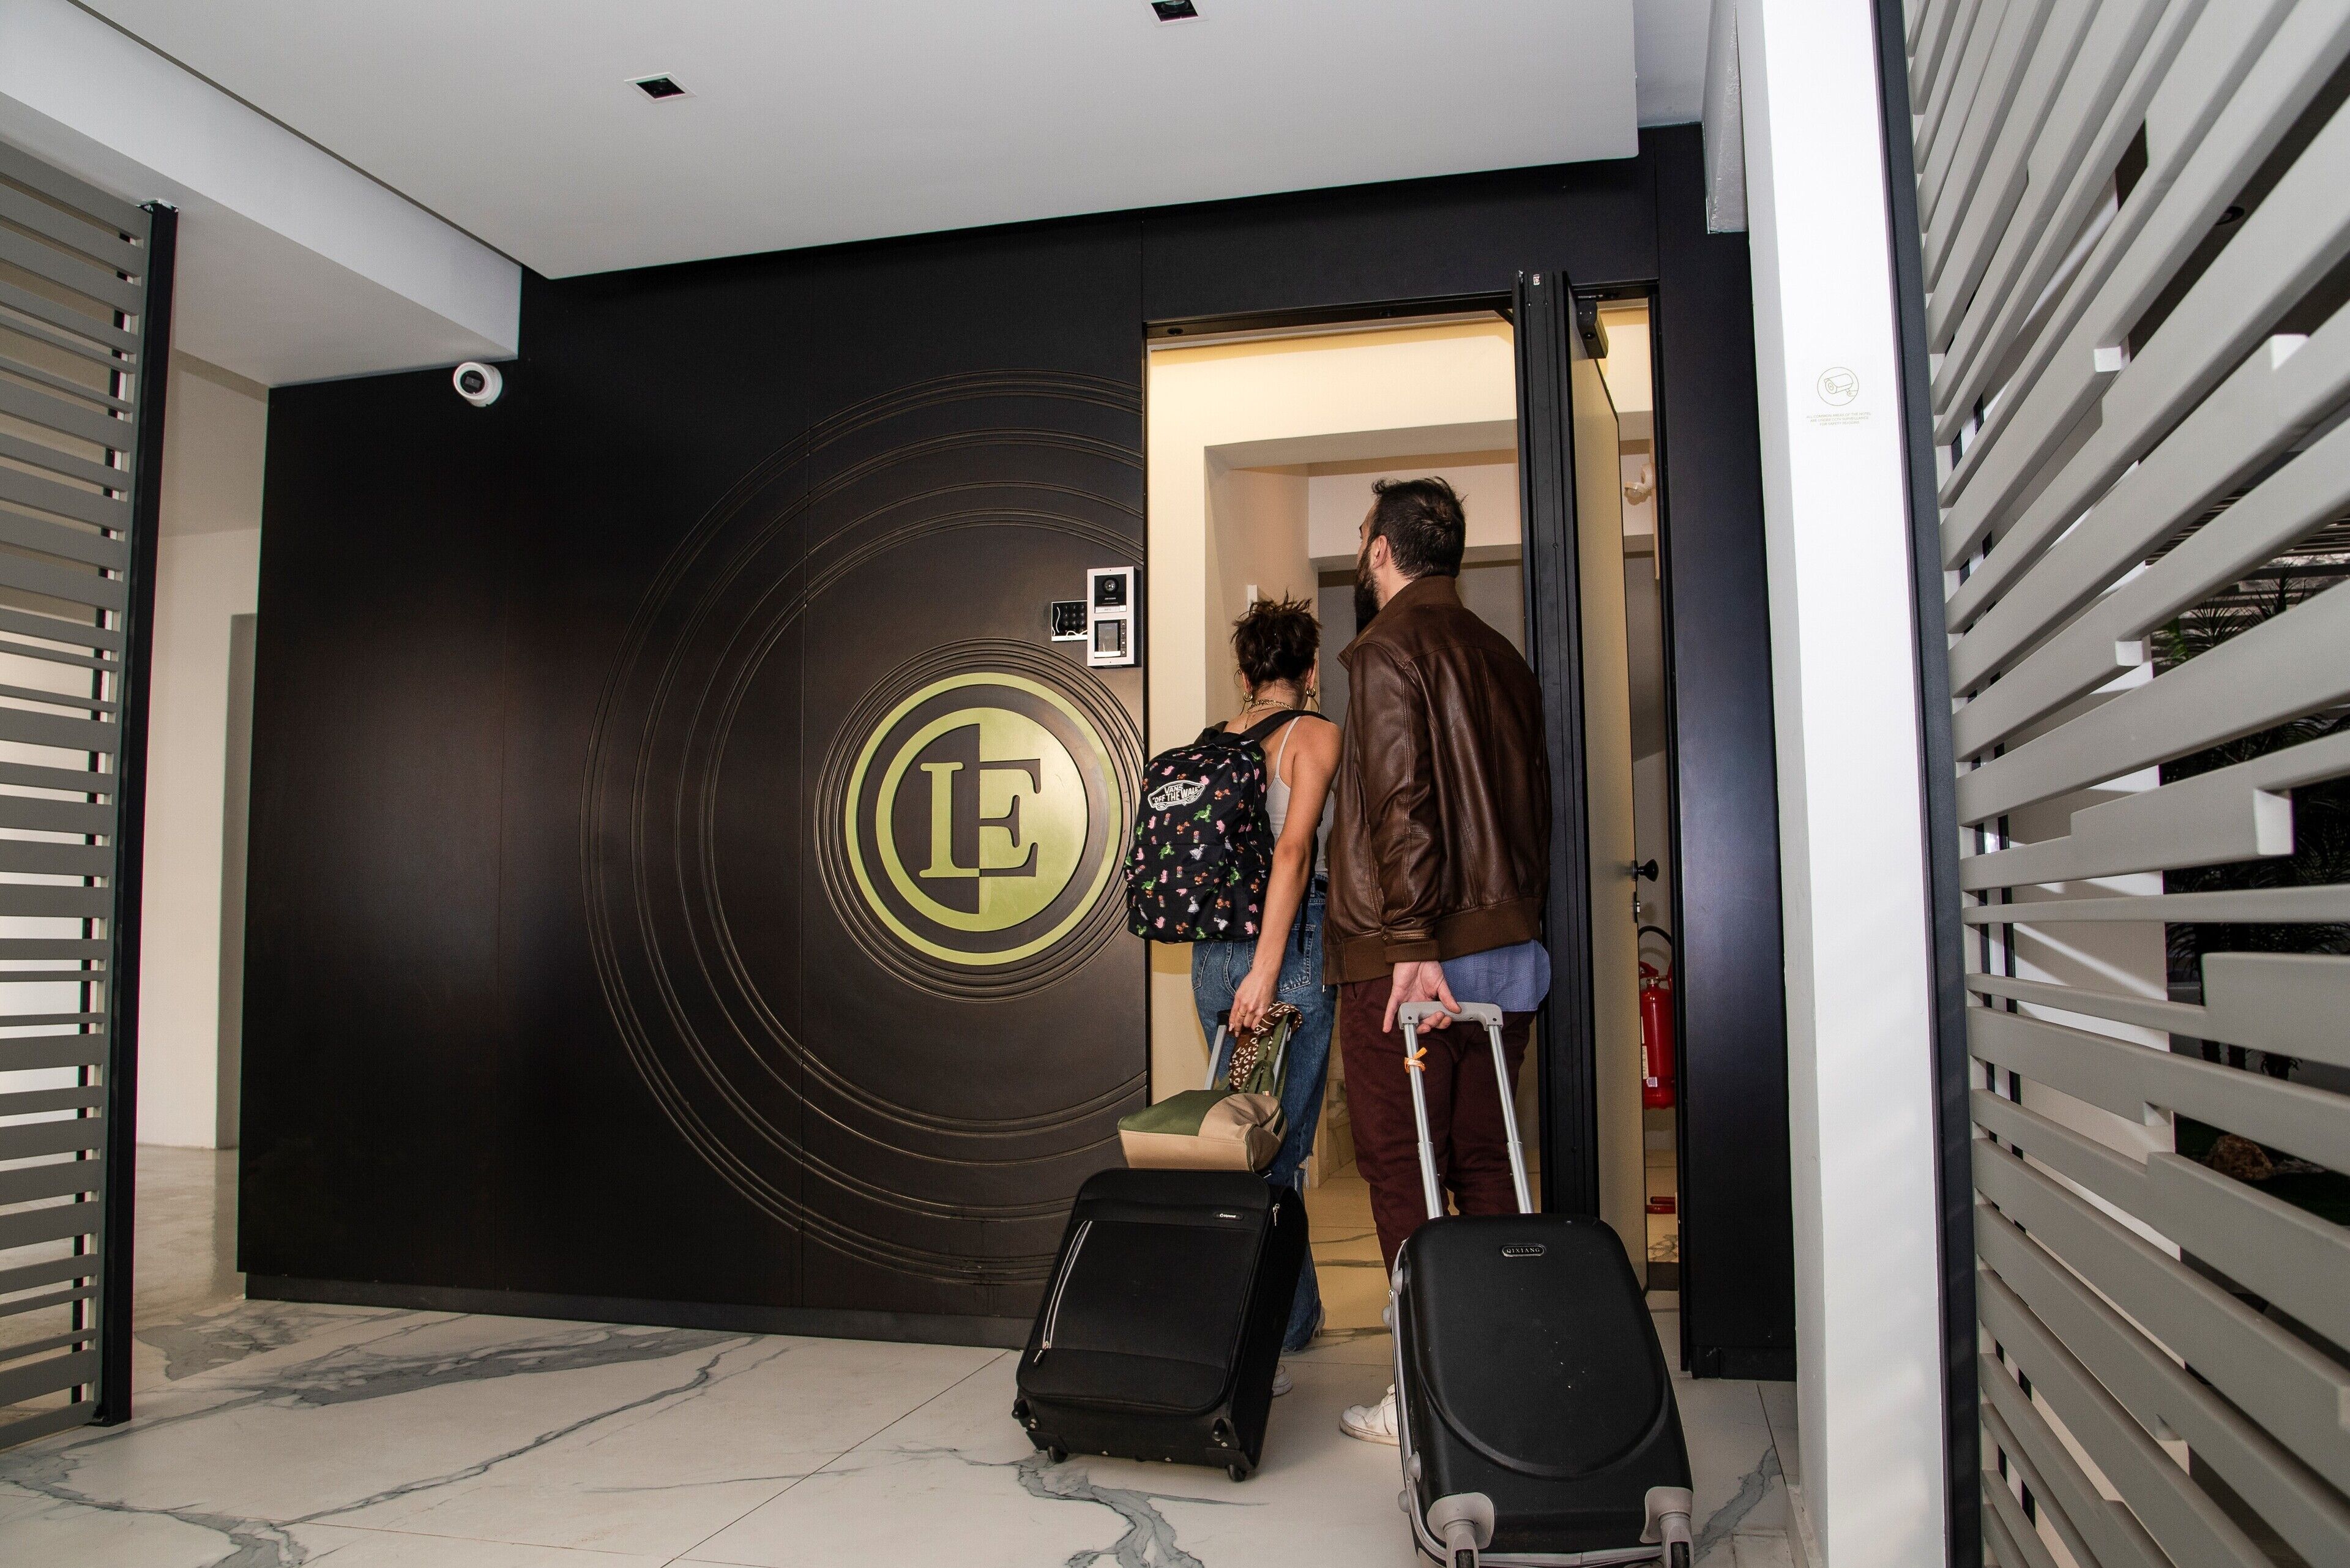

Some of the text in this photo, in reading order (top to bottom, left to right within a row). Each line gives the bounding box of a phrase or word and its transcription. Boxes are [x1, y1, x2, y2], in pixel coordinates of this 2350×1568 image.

[1164, 783, 1184, 794] VANS
[1166, 790, 1180, 802] THE
[919, 759, 1041, 878] LE
